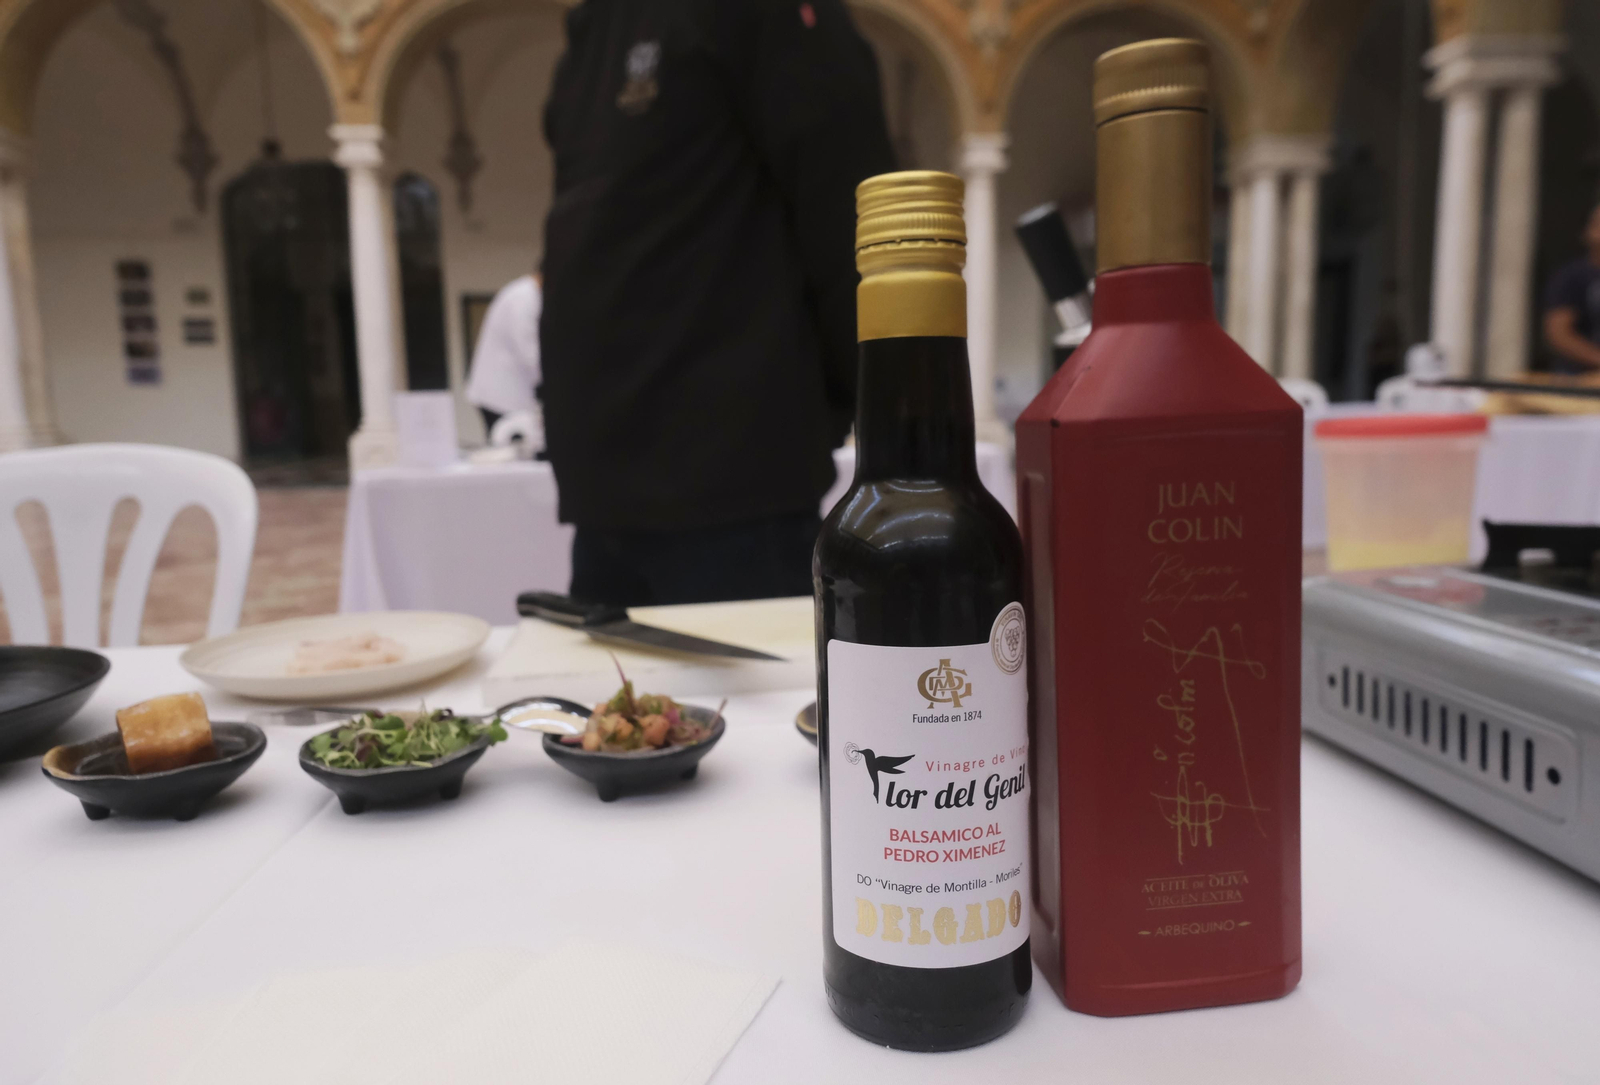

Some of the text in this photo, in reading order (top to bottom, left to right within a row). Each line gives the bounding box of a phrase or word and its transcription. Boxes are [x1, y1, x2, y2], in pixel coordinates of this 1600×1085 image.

[1158, 480, 1235, 515] JUAN
[1147, 515, 1243, 544] COLIN
[912, 710, 982, 723] Fundada en 1874
[925, 757, 985, 773] Vinagre
[992, 753, 1005, 766] de
[934, 779, 976, 809] del
[984, 763, 1026, 811] Genil
[889, 822, 1001, 844] BALSAMICO AL
[884, 839, 1006, 863] PEDRO XIMENEZ
[856, 873, 872, 886] DO
[925, 883, 940, 893] de
[944, 878, 987, 893] Montilla
[1141, 879, 1190, 894] ACEITE
[1208, 874, 1249, 888] OLIVA
[1148, 889, 1243, 907] VIRGEN EXTRA
[855, 889, 1022, 946] DELGADO
[1154, 919, 1236, 937] ARBEQUINO
